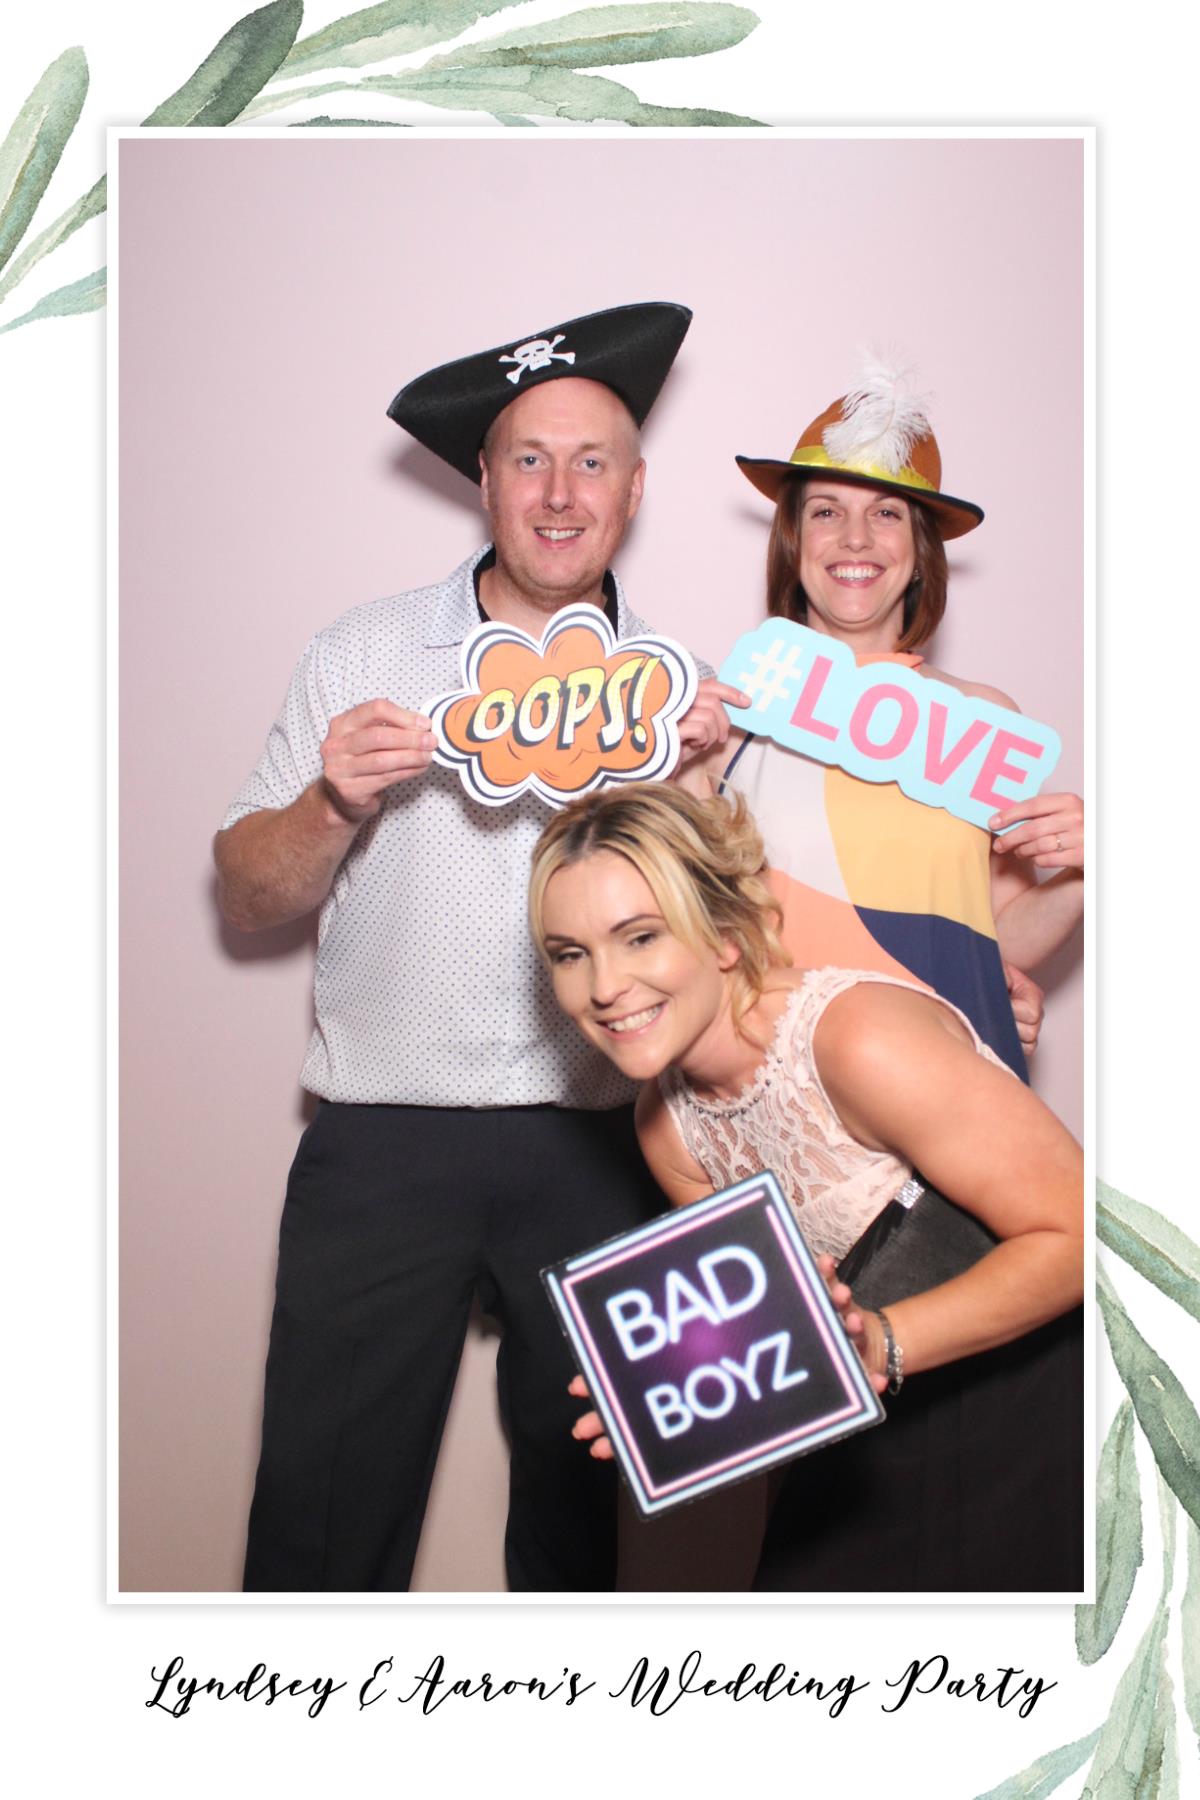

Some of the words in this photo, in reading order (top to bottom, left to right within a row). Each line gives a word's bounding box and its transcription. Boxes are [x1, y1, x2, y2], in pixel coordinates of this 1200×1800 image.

[464, 653, 664, 753] OOPS!
[736, 637, 1045, 811] #LOVE
[605, 1245, 768, 1362] BAD
[644, 1330, 810, 1440] BOYZ
